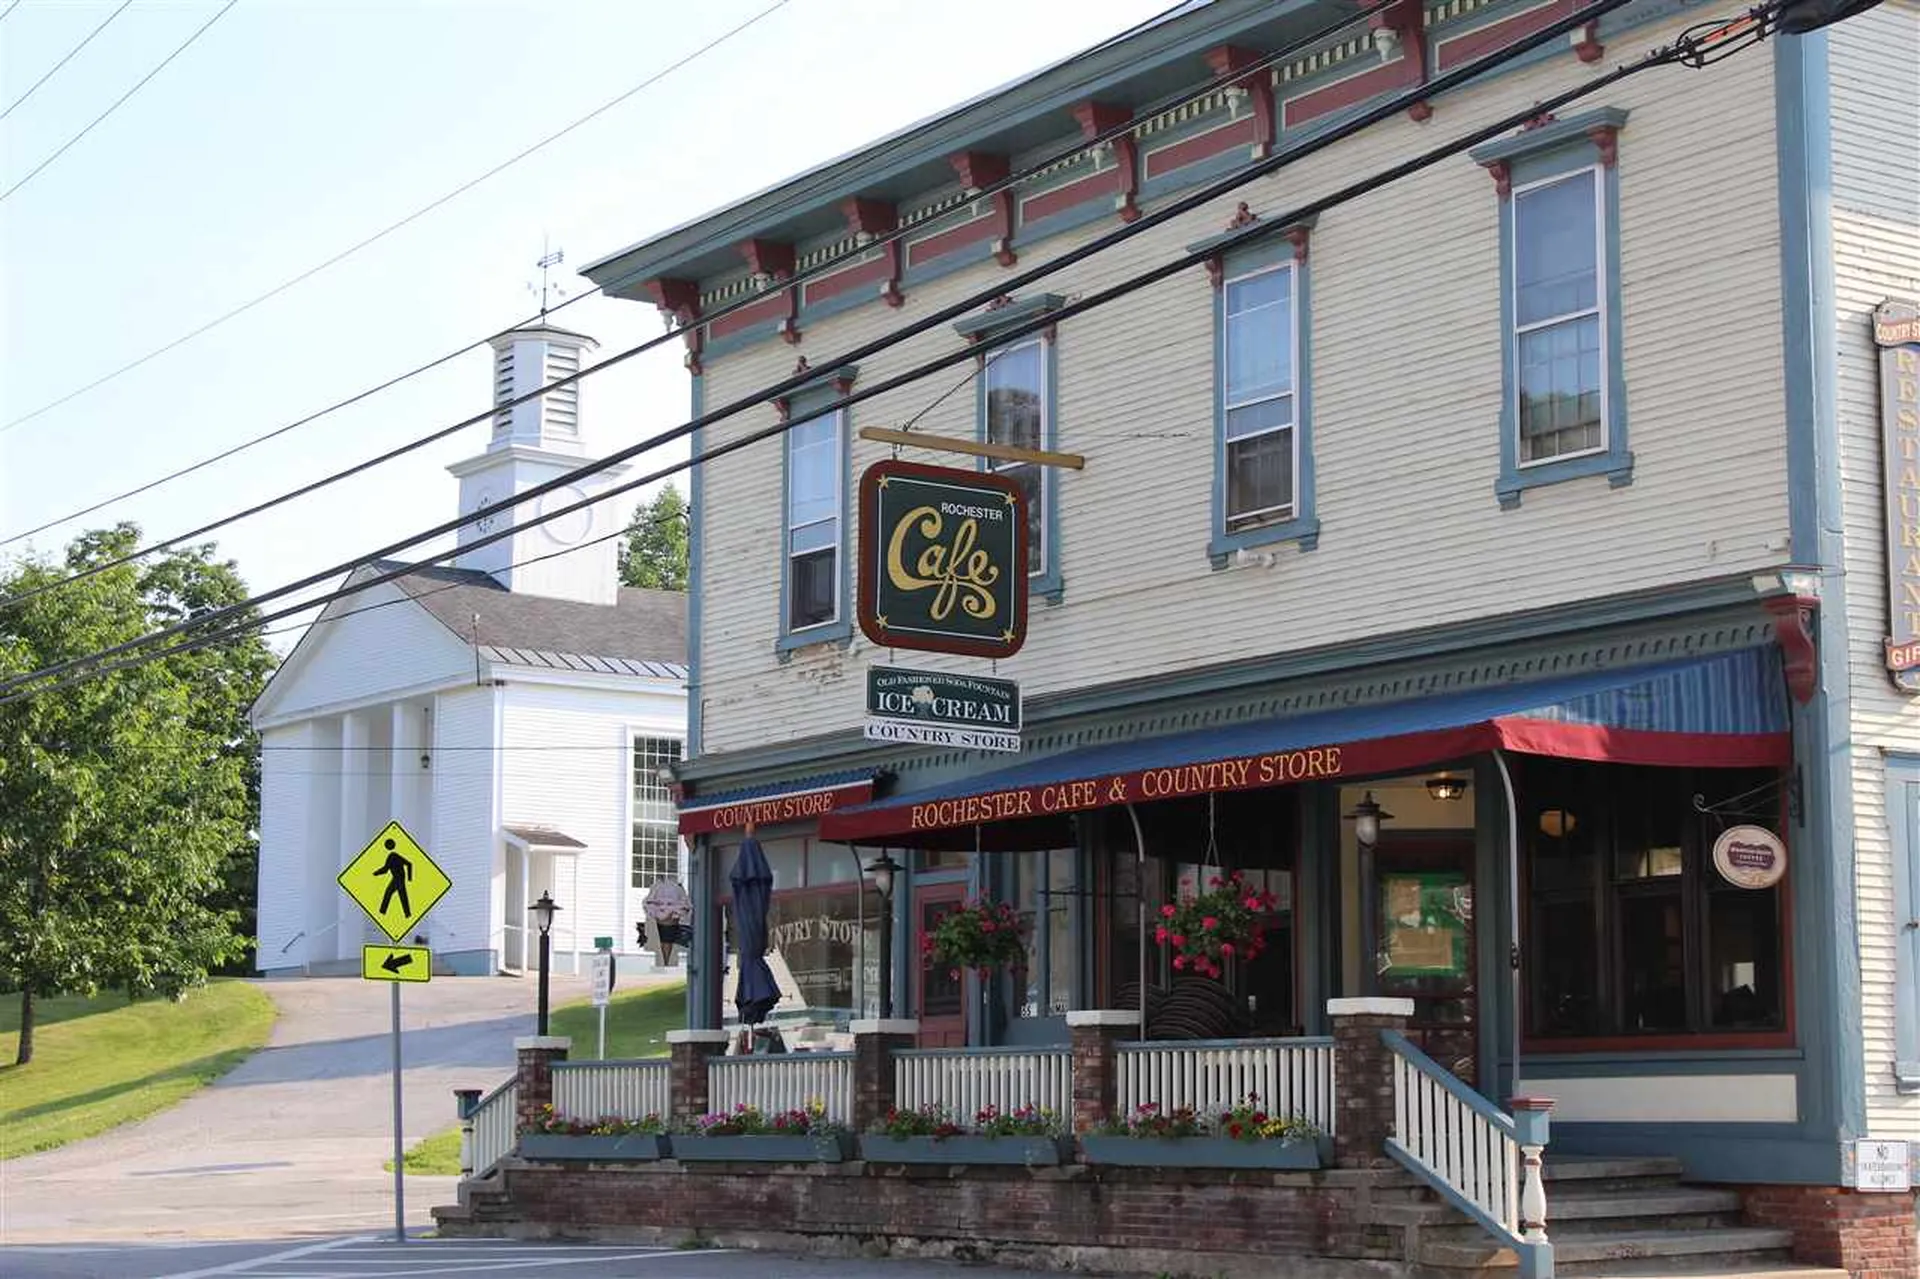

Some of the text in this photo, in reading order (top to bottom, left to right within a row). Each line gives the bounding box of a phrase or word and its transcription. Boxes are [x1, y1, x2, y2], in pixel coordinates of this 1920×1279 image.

[941, 502, 1003, 521] ROCHESTER
[887, 506, 999, 621] Cafe
[877, 676, 897, 687] OLD
[967, 680, 1011, 700] FOUNTAIN
[877, 692, 1011, 723] ICE CREAM
[869, 724, 1019, 750] COUNTRY STORE
[911, 747, 1342, 829] ROCHESTER CAFE & COUNTRY STORE
[713, 792, 834, 829] COUNTRY STORE
[1877, 1143, 1889, 1161] NO
